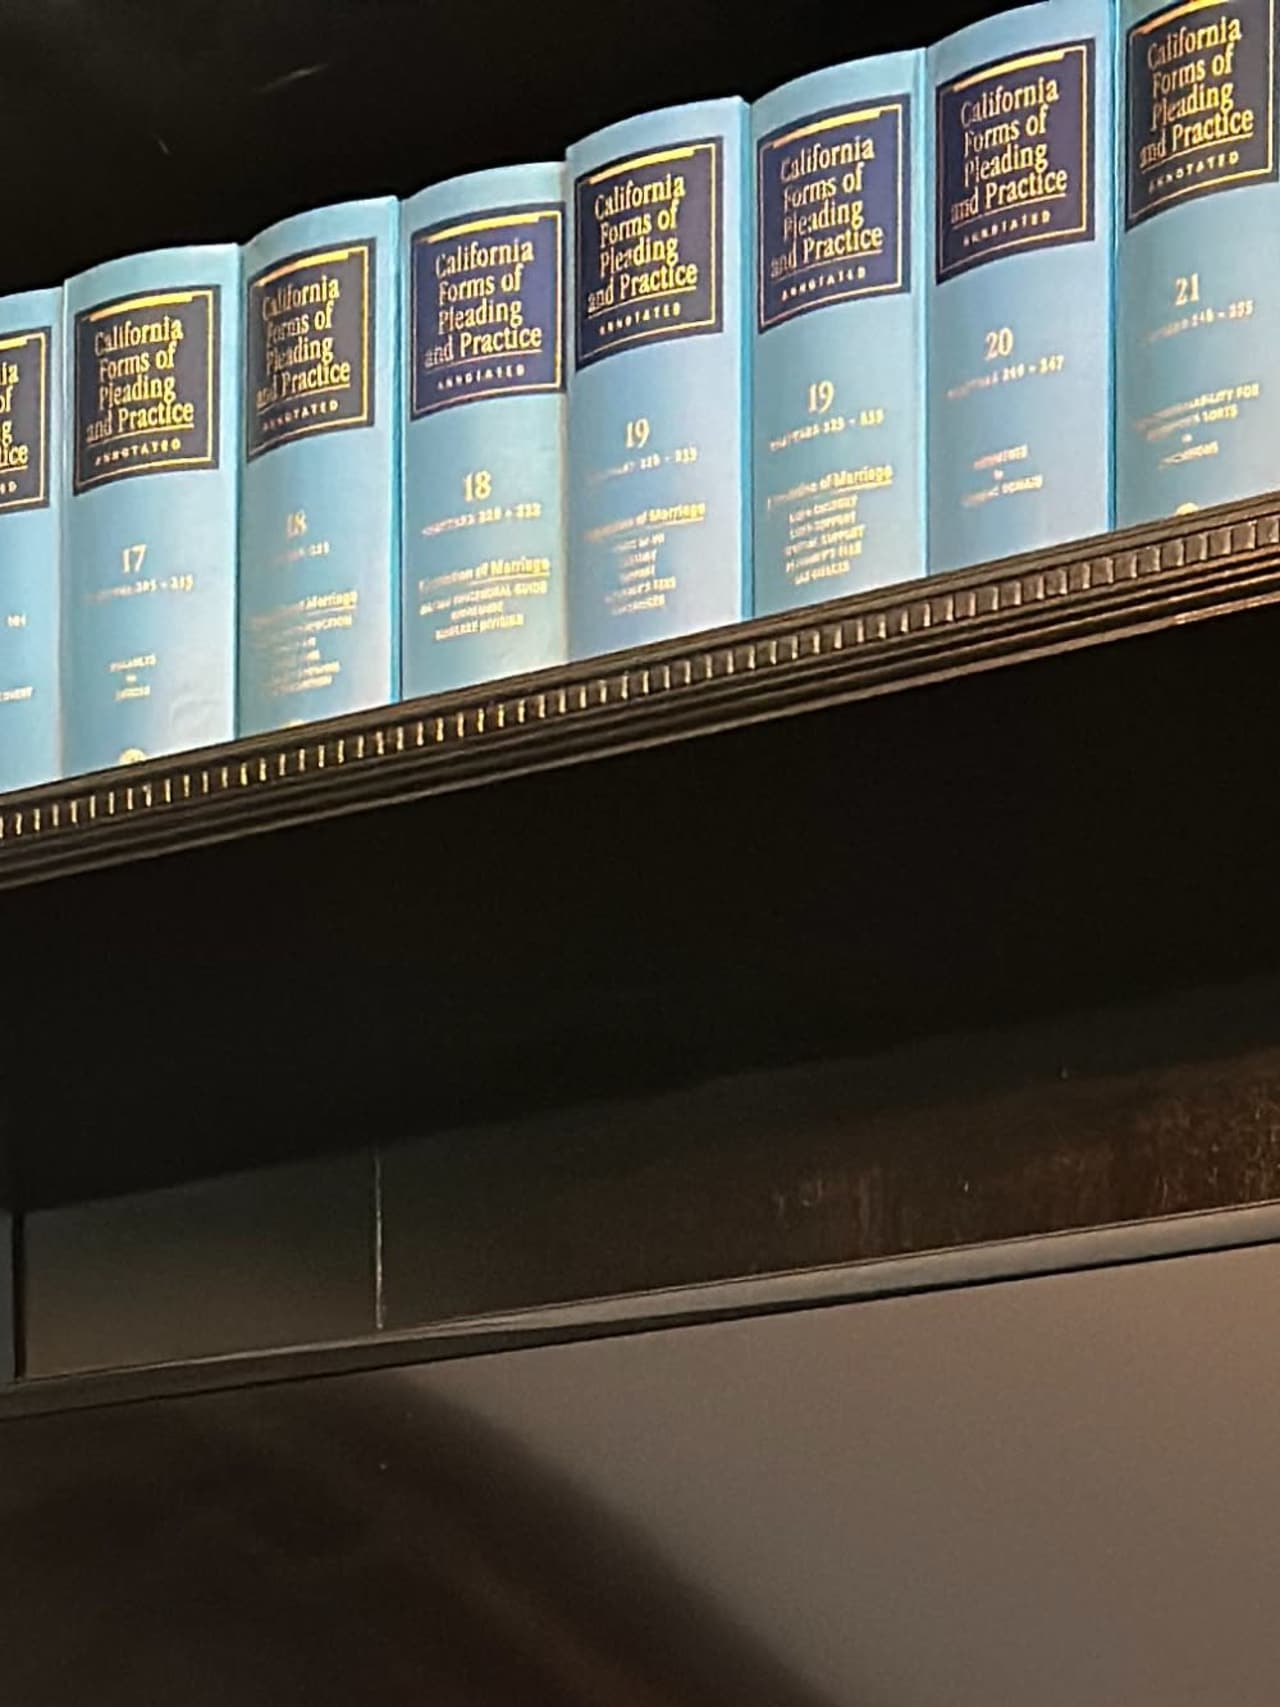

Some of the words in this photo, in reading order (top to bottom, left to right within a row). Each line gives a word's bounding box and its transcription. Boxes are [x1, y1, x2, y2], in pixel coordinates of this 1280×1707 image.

[1148, 16, 1242, 70] California
[1152, 55, 1207, 95] Forms
[1212, 43, 1234, 74] of
[961, 78, 1059, 129] California
[1151, 80, 1233, 128] Pleading
[964, 118, 1021, 154] Forms
[1026, 107, 1048, 137] of
[1140, 137, 1166, 169] and
[1172, 107, 1254, 150] Practice
[780, 136, 875, 183] California
[964, 142, 1048, 186] Pleading
[594, 172, 685, 221] California
[784, 175, 836, 210] Forms
[842, 164, 864, 194] of
[951, 192, 979, 223] and
[985, 166, 1068, 208] Practice
[600, 215, 651, 248] Forms
[657, 204, 679, 232] of
[784, 201, 864, 242] Pleading
[435, 239, 534, 279] California
[599, 238, 678, 276] Pleading
[771, 249, 797, 278] and
[803, 225, 884, 264] Practice
[439, 273, 495, 304] Forms
[501, 263, 523, 292] of
[587, 287, 615, 315] and
[620, 263, 697, 302] Practice
[1175, 273, 1199, 306] 21
[94, 315, 183, 355] California
[438, 297, 523, 334] Pleading
[99, 353, 151, 383] Forms
[155, 343, 176, 371] of
[425, 341, 453, 368] and
[459, 326, 542, 356] Practice
[985, 327, 1013, 361] 20
[99, 376, 176, 406] Pleading
[807, 381, 834, 413] 19
[118, 400, 194, 429] Practice
[626, 418, 649, 448] 19
[463, 473, 492, 501] 18
[121, 544, 146, 575] 17
